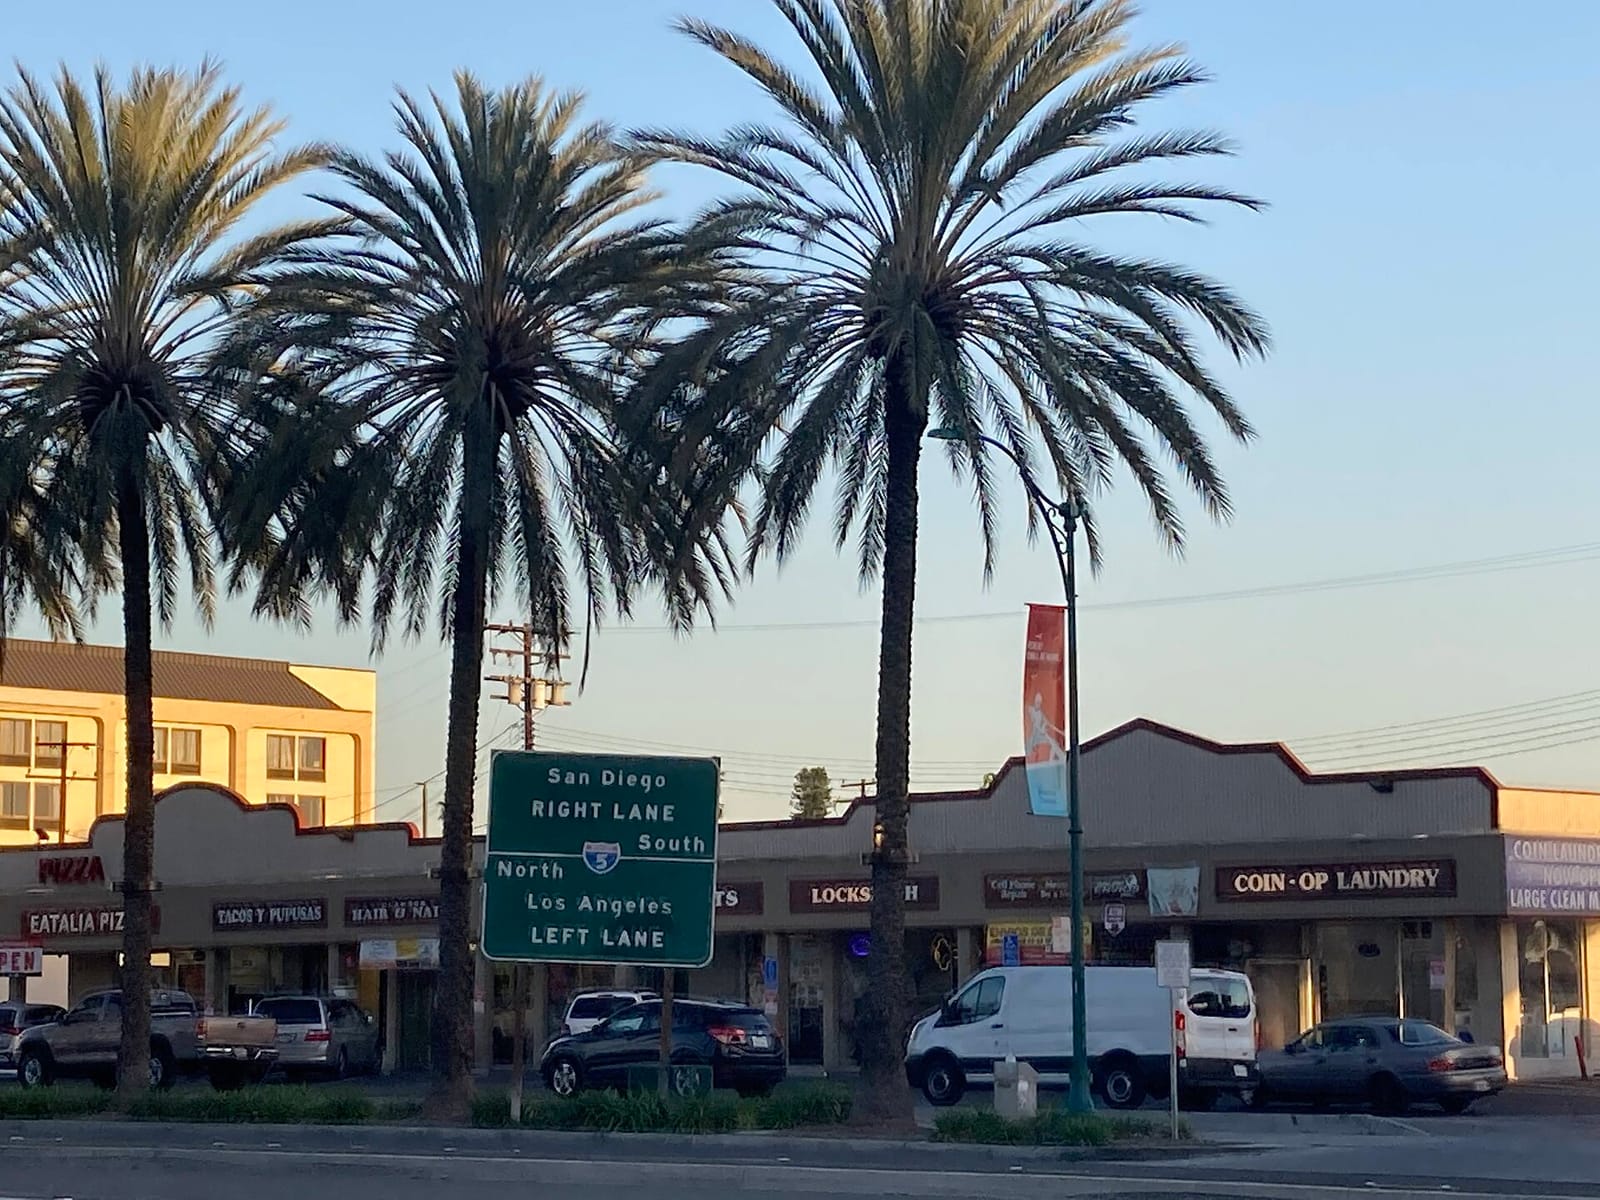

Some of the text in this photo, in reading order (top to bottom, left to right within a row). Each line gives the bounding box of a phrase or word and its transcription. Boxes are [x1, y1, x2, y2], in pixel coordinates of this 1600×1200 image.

[547, 768, 667, 793] San Diego
[532, 800, 675, 822] RIGHT LANE
[638, 834, 706, 852] South
[38, 855, 105, 884] PIZZA
[497, 861, 563, 879] North
[595, 853, 608, 870] 5
[1336, 868, 1440, 890] LAUNDRY
[527, 893, 673, 919] Los Angeles
[1510, 888, 1547, 909] LARGE
[1550, 889, 1585, 910] CLEAN
[30, 911, 125, 934] EATALIA PIZ
[217, 905, 323, 924] TACOS Y PUPUSAS
[352, 908, 388, 921] HAIR
[531, 927, 664, 948] LEFT LANE
[0, 951, 35, 971] PEN
